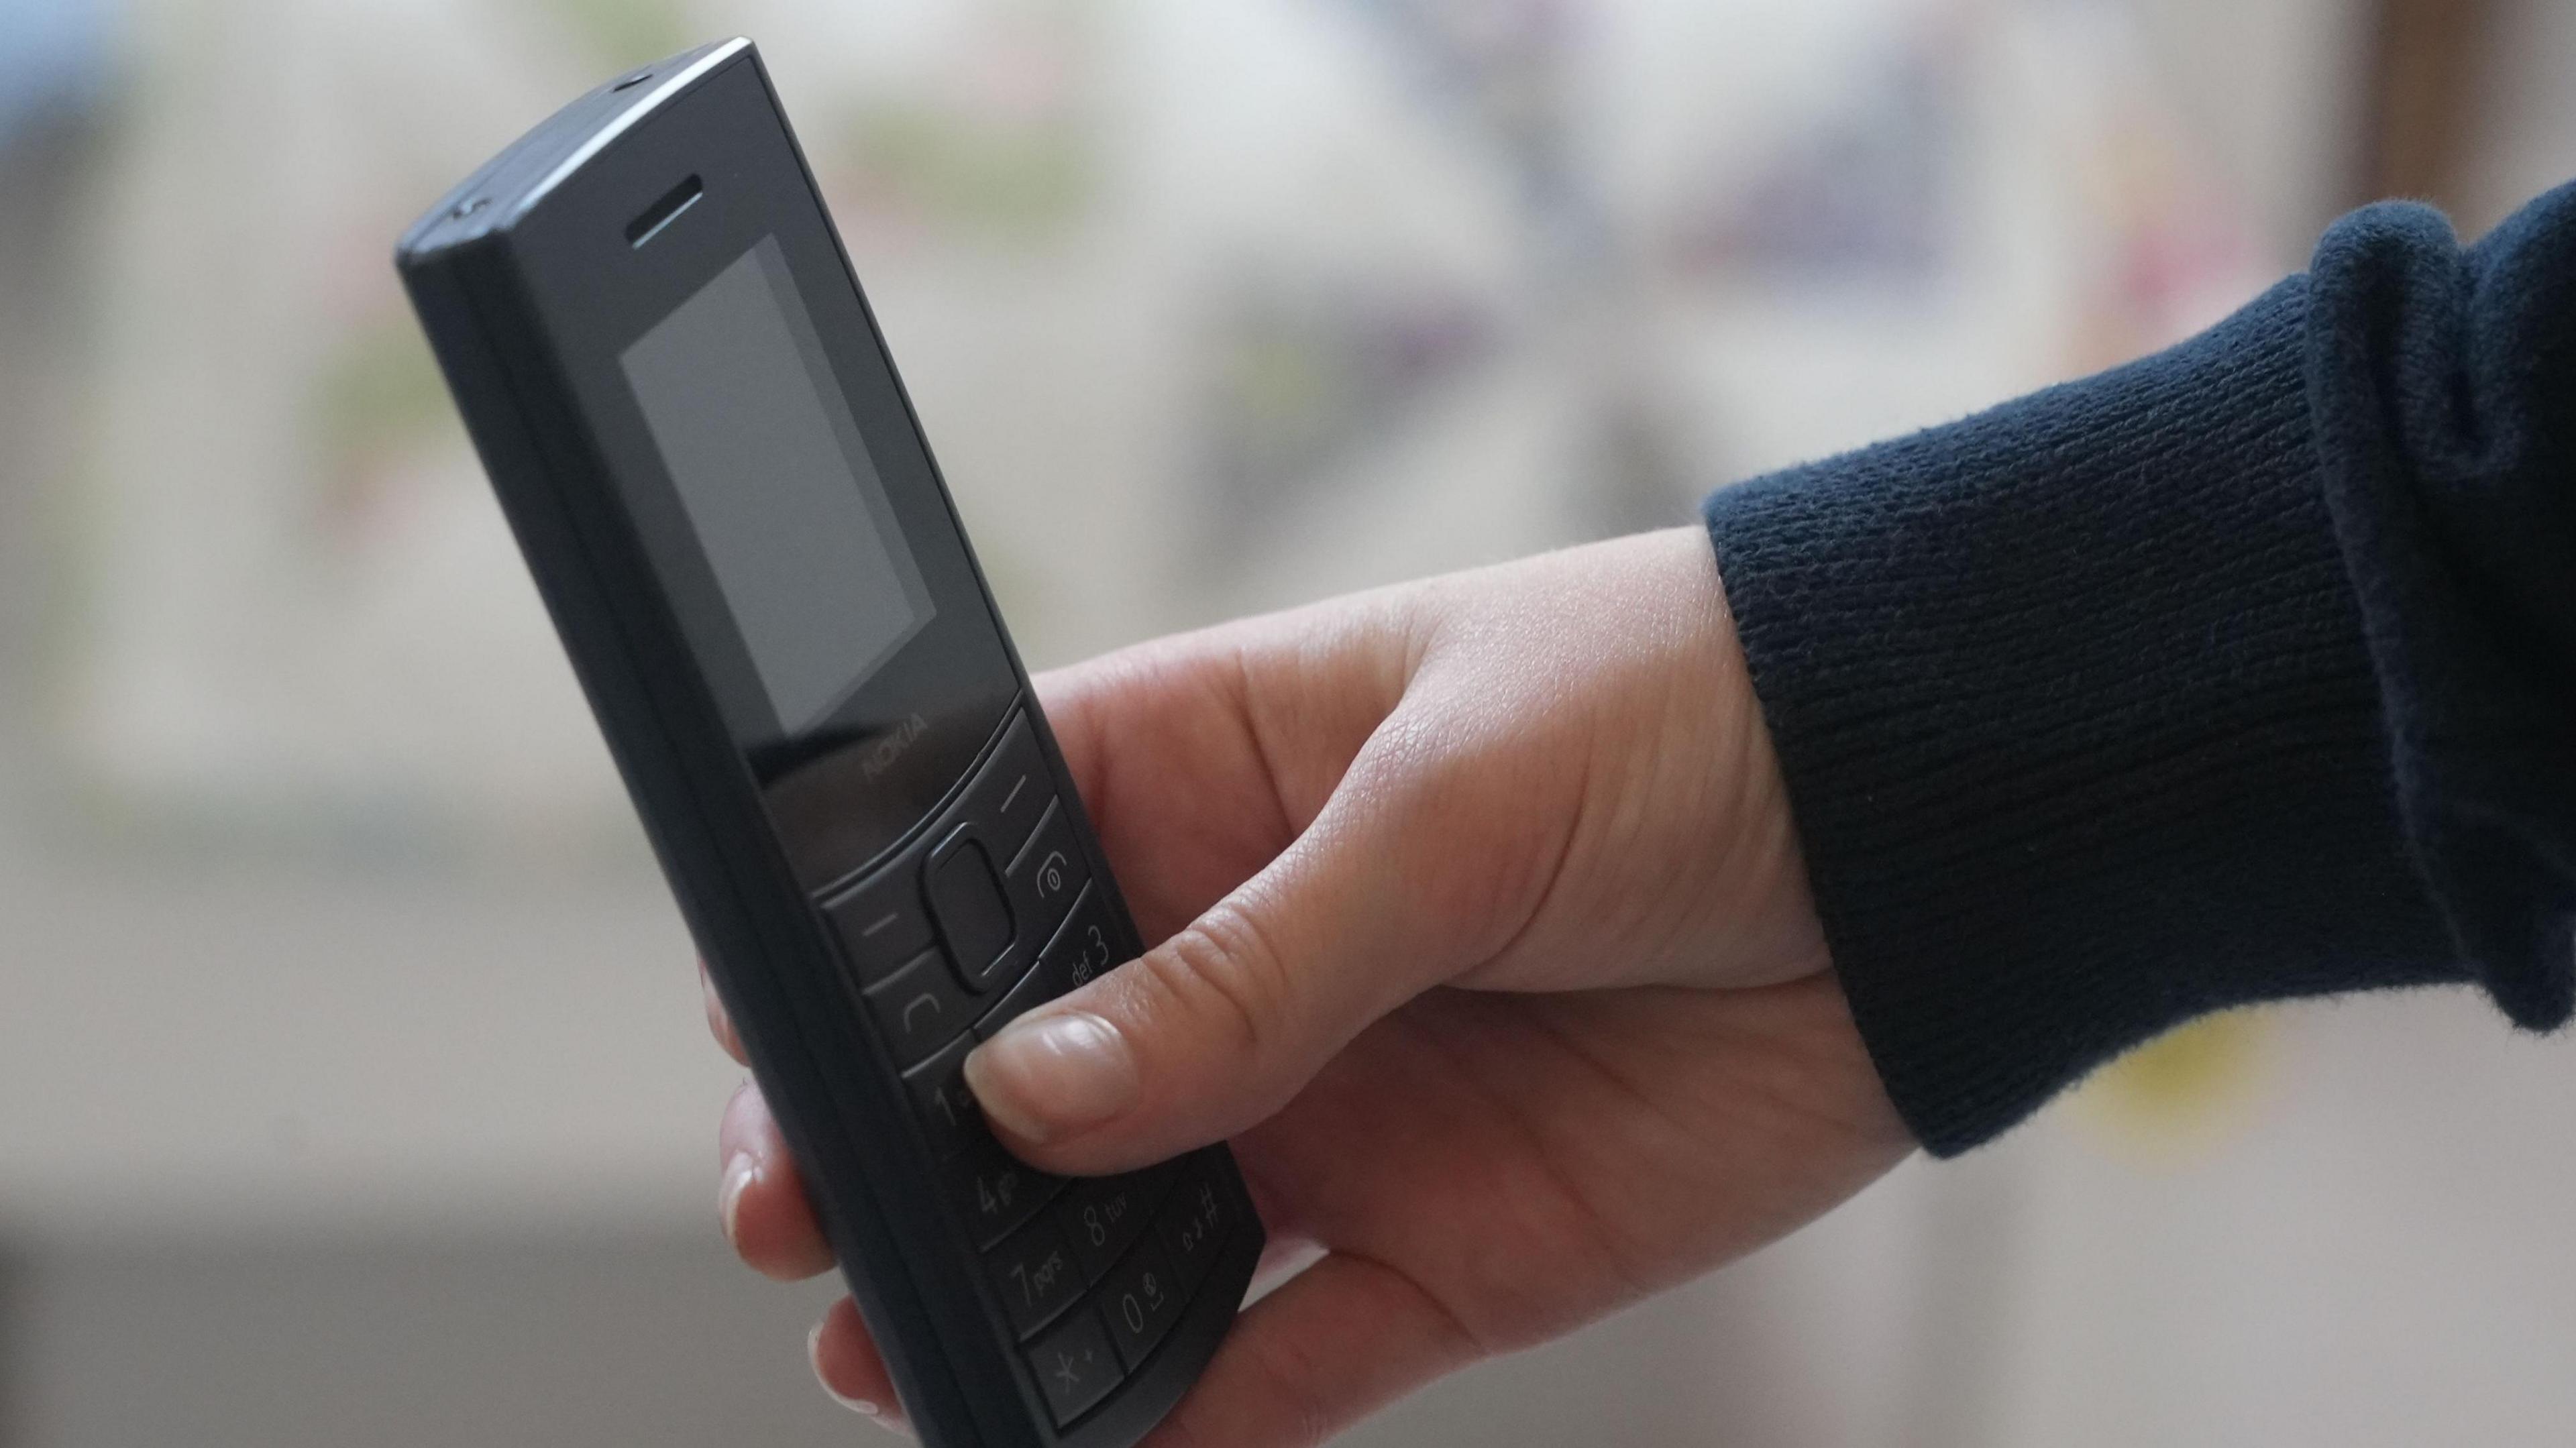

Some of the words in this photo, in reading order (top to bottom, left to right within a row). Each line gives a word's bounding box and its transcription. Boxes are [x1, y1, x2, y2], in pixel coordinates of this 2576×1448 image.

[862, 712, 928, 782] NOKIA
[1072, 950, 1093, 988] def
[1087, 925, 1109, 966] 3
[934, 1086, 957, 1127] 1
[977, 1176, 998, 1215] 4
[1083, 1205, 1106, 1247] 8
[1009, 1262, 1032, 1308] 7
[1122, 1293, 1143, 1334] 0
